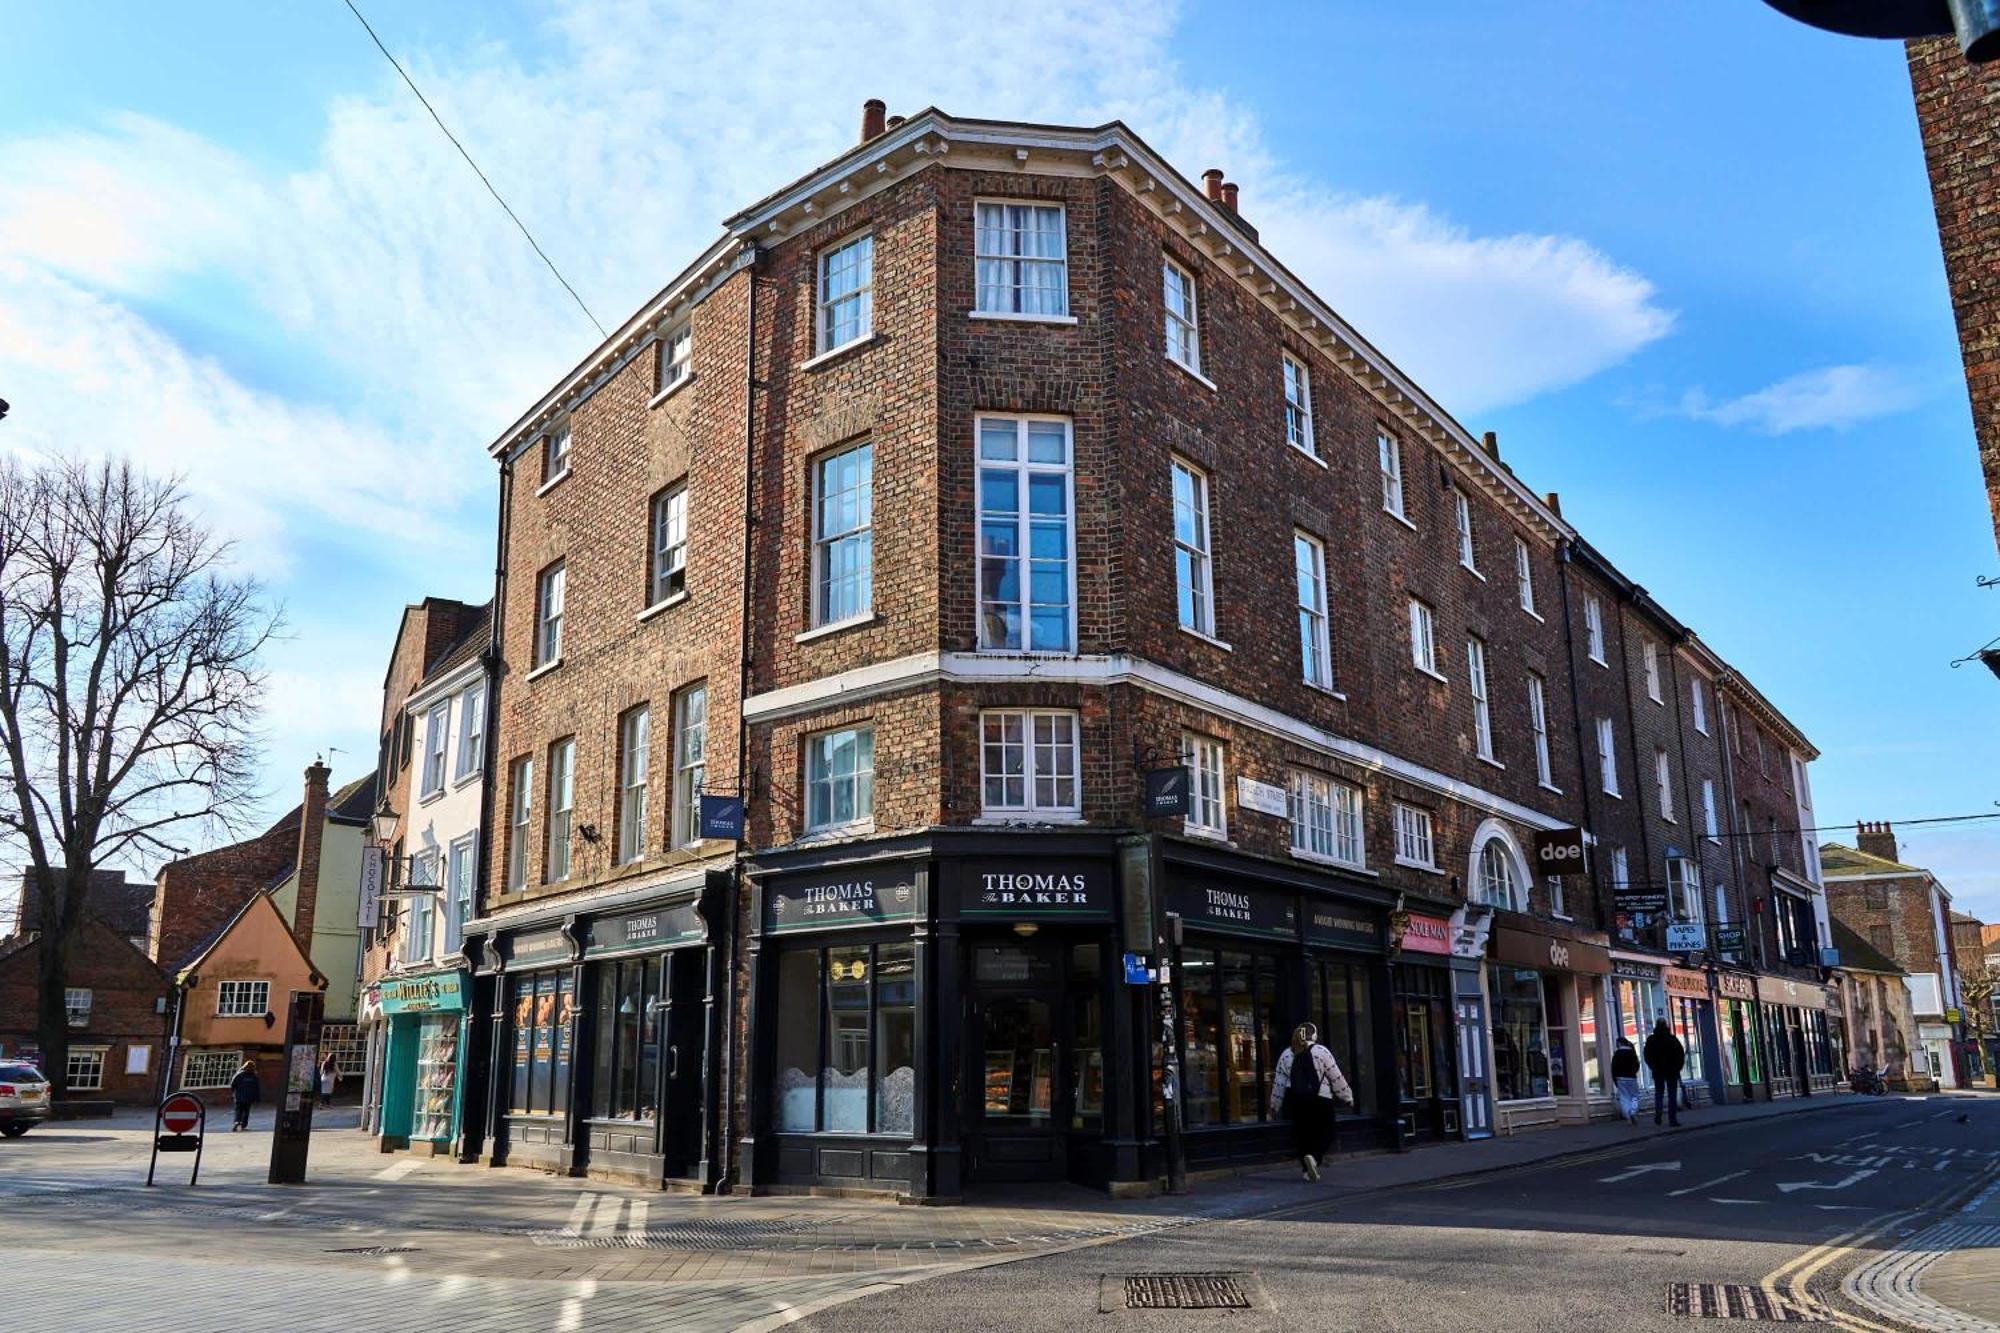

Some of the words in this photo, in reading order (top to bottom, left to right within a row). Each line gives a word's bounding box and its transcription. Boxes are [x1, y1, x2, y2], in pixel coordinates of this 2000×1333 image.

[1541, 842, 1580, 860] doe
[982, 874, 1085, 890] THOMAS
[805, 881, 873, 903] THOMAS
[1001, 892, 1088, 903] BAKER
[1206, 889, 1249, 909] THOMAS
[816, 899, 874, 915] BAKER
[1215, 907, 1250, 920] BAKER
[627, 917, 657, 931] THOMAS
[1718, 931, 1740, 940] SHOP
[1550, 939, 1568, 967] doe
[1670, 941, 1700, 949] PHONES
